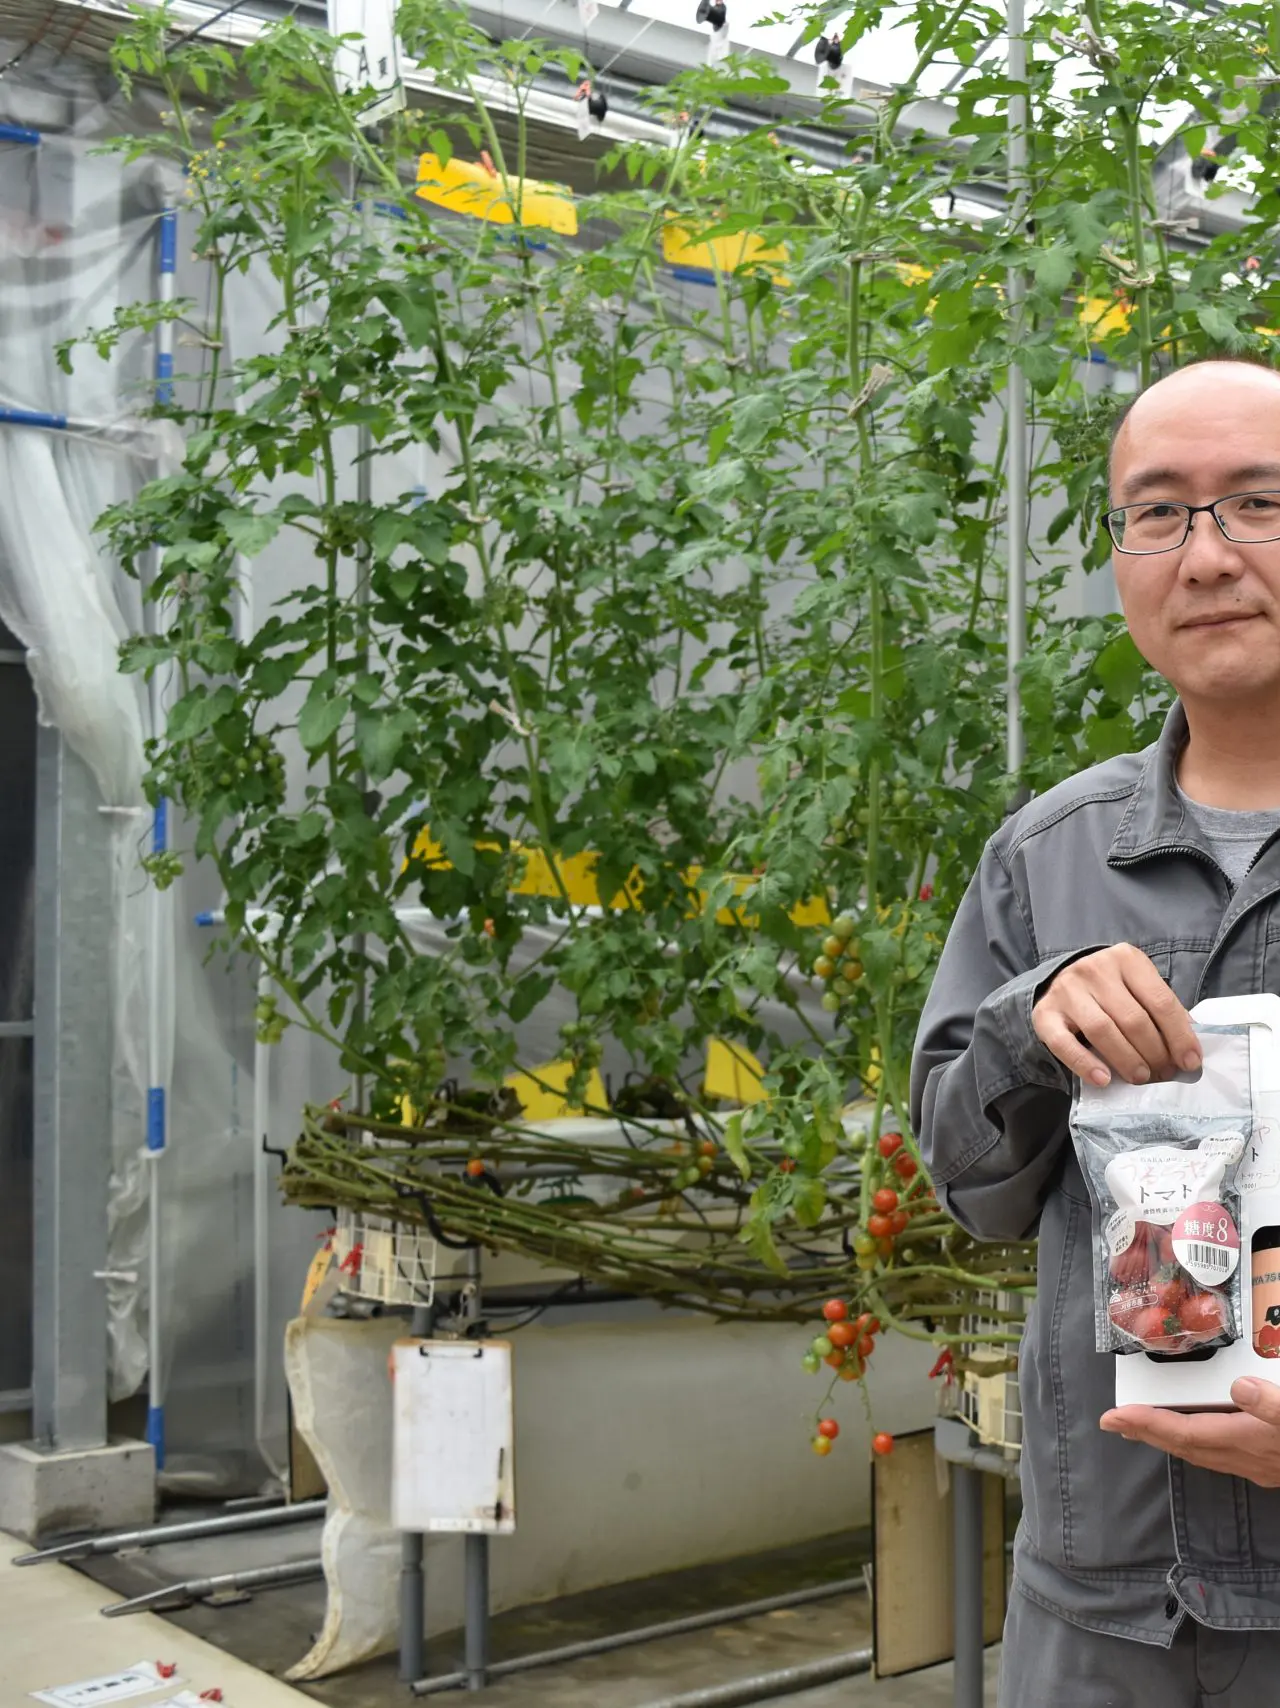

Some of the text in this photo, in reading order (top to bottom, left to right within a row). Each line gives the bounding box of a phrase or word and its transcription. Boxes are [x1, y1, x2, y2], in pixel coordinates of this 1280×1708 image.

[1140, 1184, 1192, 1204] トマト
[1265, 1272, 1277, 1283] 75
